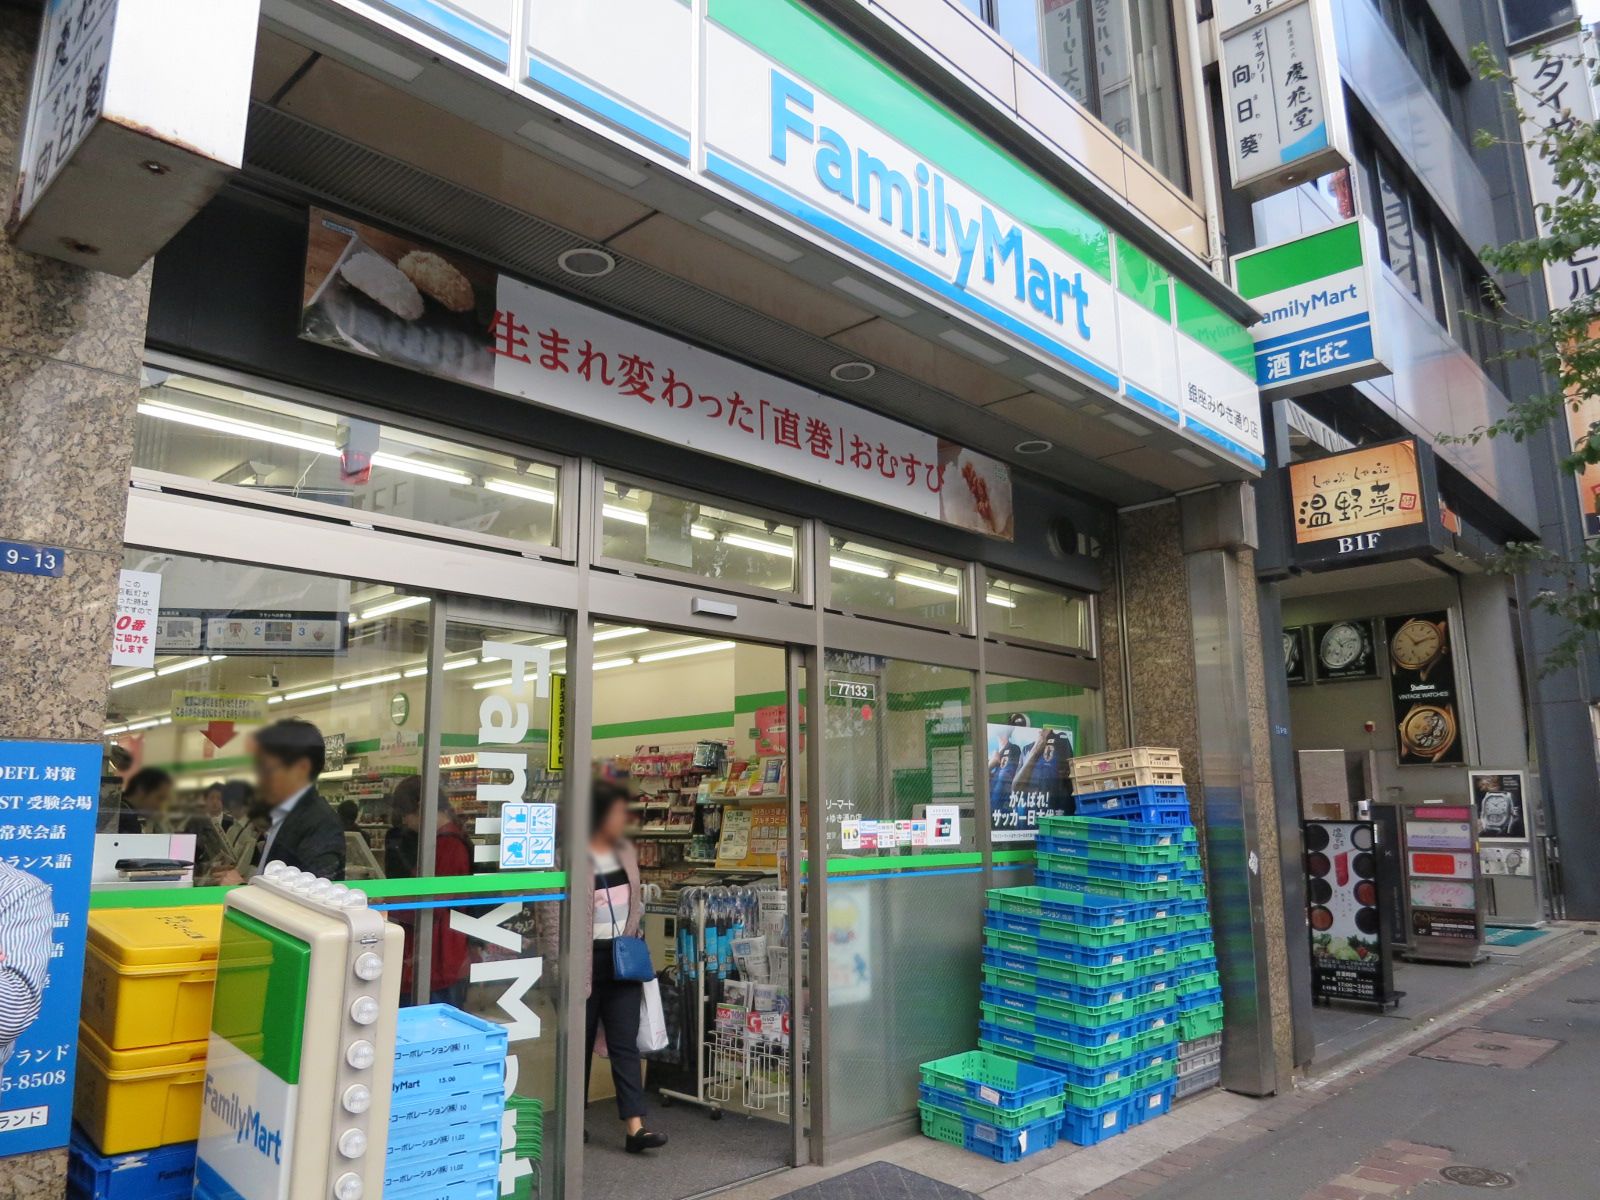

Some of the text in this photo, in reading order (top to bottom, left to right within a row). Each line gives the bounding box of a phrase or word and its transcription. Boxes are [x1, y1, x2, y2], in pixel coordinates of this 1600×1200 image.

[1252, 29, 1265, 84] ギャラリー
[1231, 64, 1259, 159] 向日葵
[769, 67, 1091, 341] FamilyMart
[1250, 283, 1358, 328] amilyMart
[1266, 339, 1350, 380] 酒 たばこ
[485, 309, 947, 494] 生まれ変わった「直巻」おむすび
[1187, 381, 1259, 440] 銀座みゆき通り店
[1298, 479, 1396, 529] 温野菜
[6, 549, 56, 570] 9-13
[124, 579, 141, 588] この
[837, 682, 868, 698] 77133
[0, 766, 76, 782] EFL 対策
[27, 795, 92, 811] 受験会場
[825, 799, 855, 810] リーマート
[1009, 791, 1050, 808] がんばれ!
[0, 824, 67, 841] 常英会話
[12, 1044, 70, 1067] ランド
[204, 1073, 282, 1166] FamilyMart
[389, 1103, 458, 1123] コーポレーション(株)
[384, 1166, 449, 1186] コーポレーション(株)
